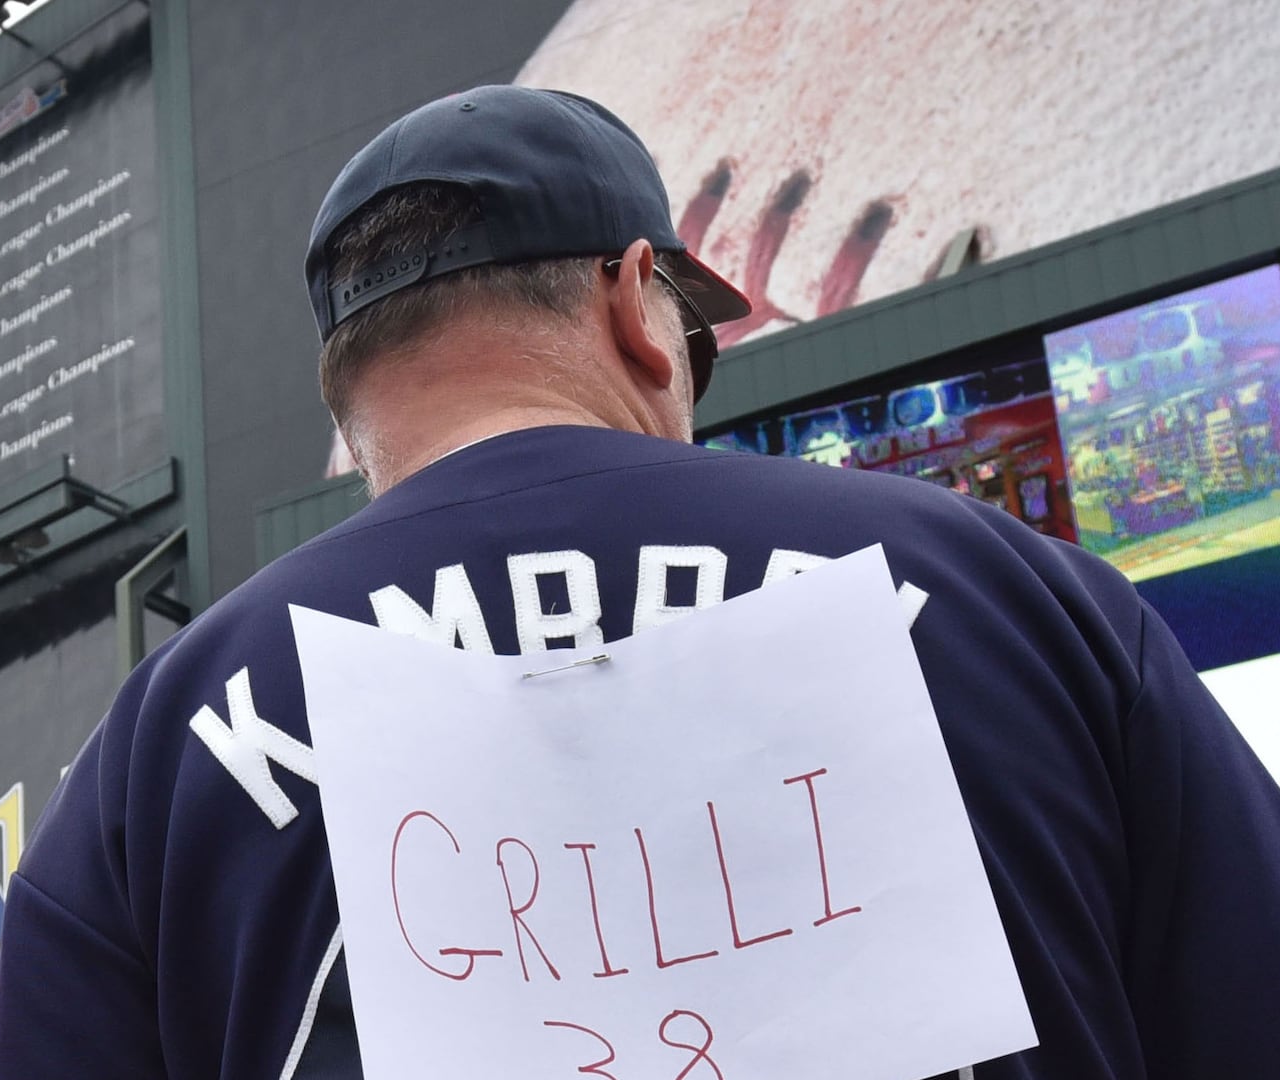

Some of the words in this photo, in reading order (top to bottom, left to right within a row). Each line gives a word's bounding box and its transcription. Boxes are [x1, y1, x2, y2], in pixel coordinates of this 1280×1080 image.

[46, 168, 130, 226] Champions
[46, 209, 132, 266] Champions
[48, 336, 135, 390] Champions
[189, 546, 928, 830] KMBR
[390, 769, 862, 982] GRILLI
